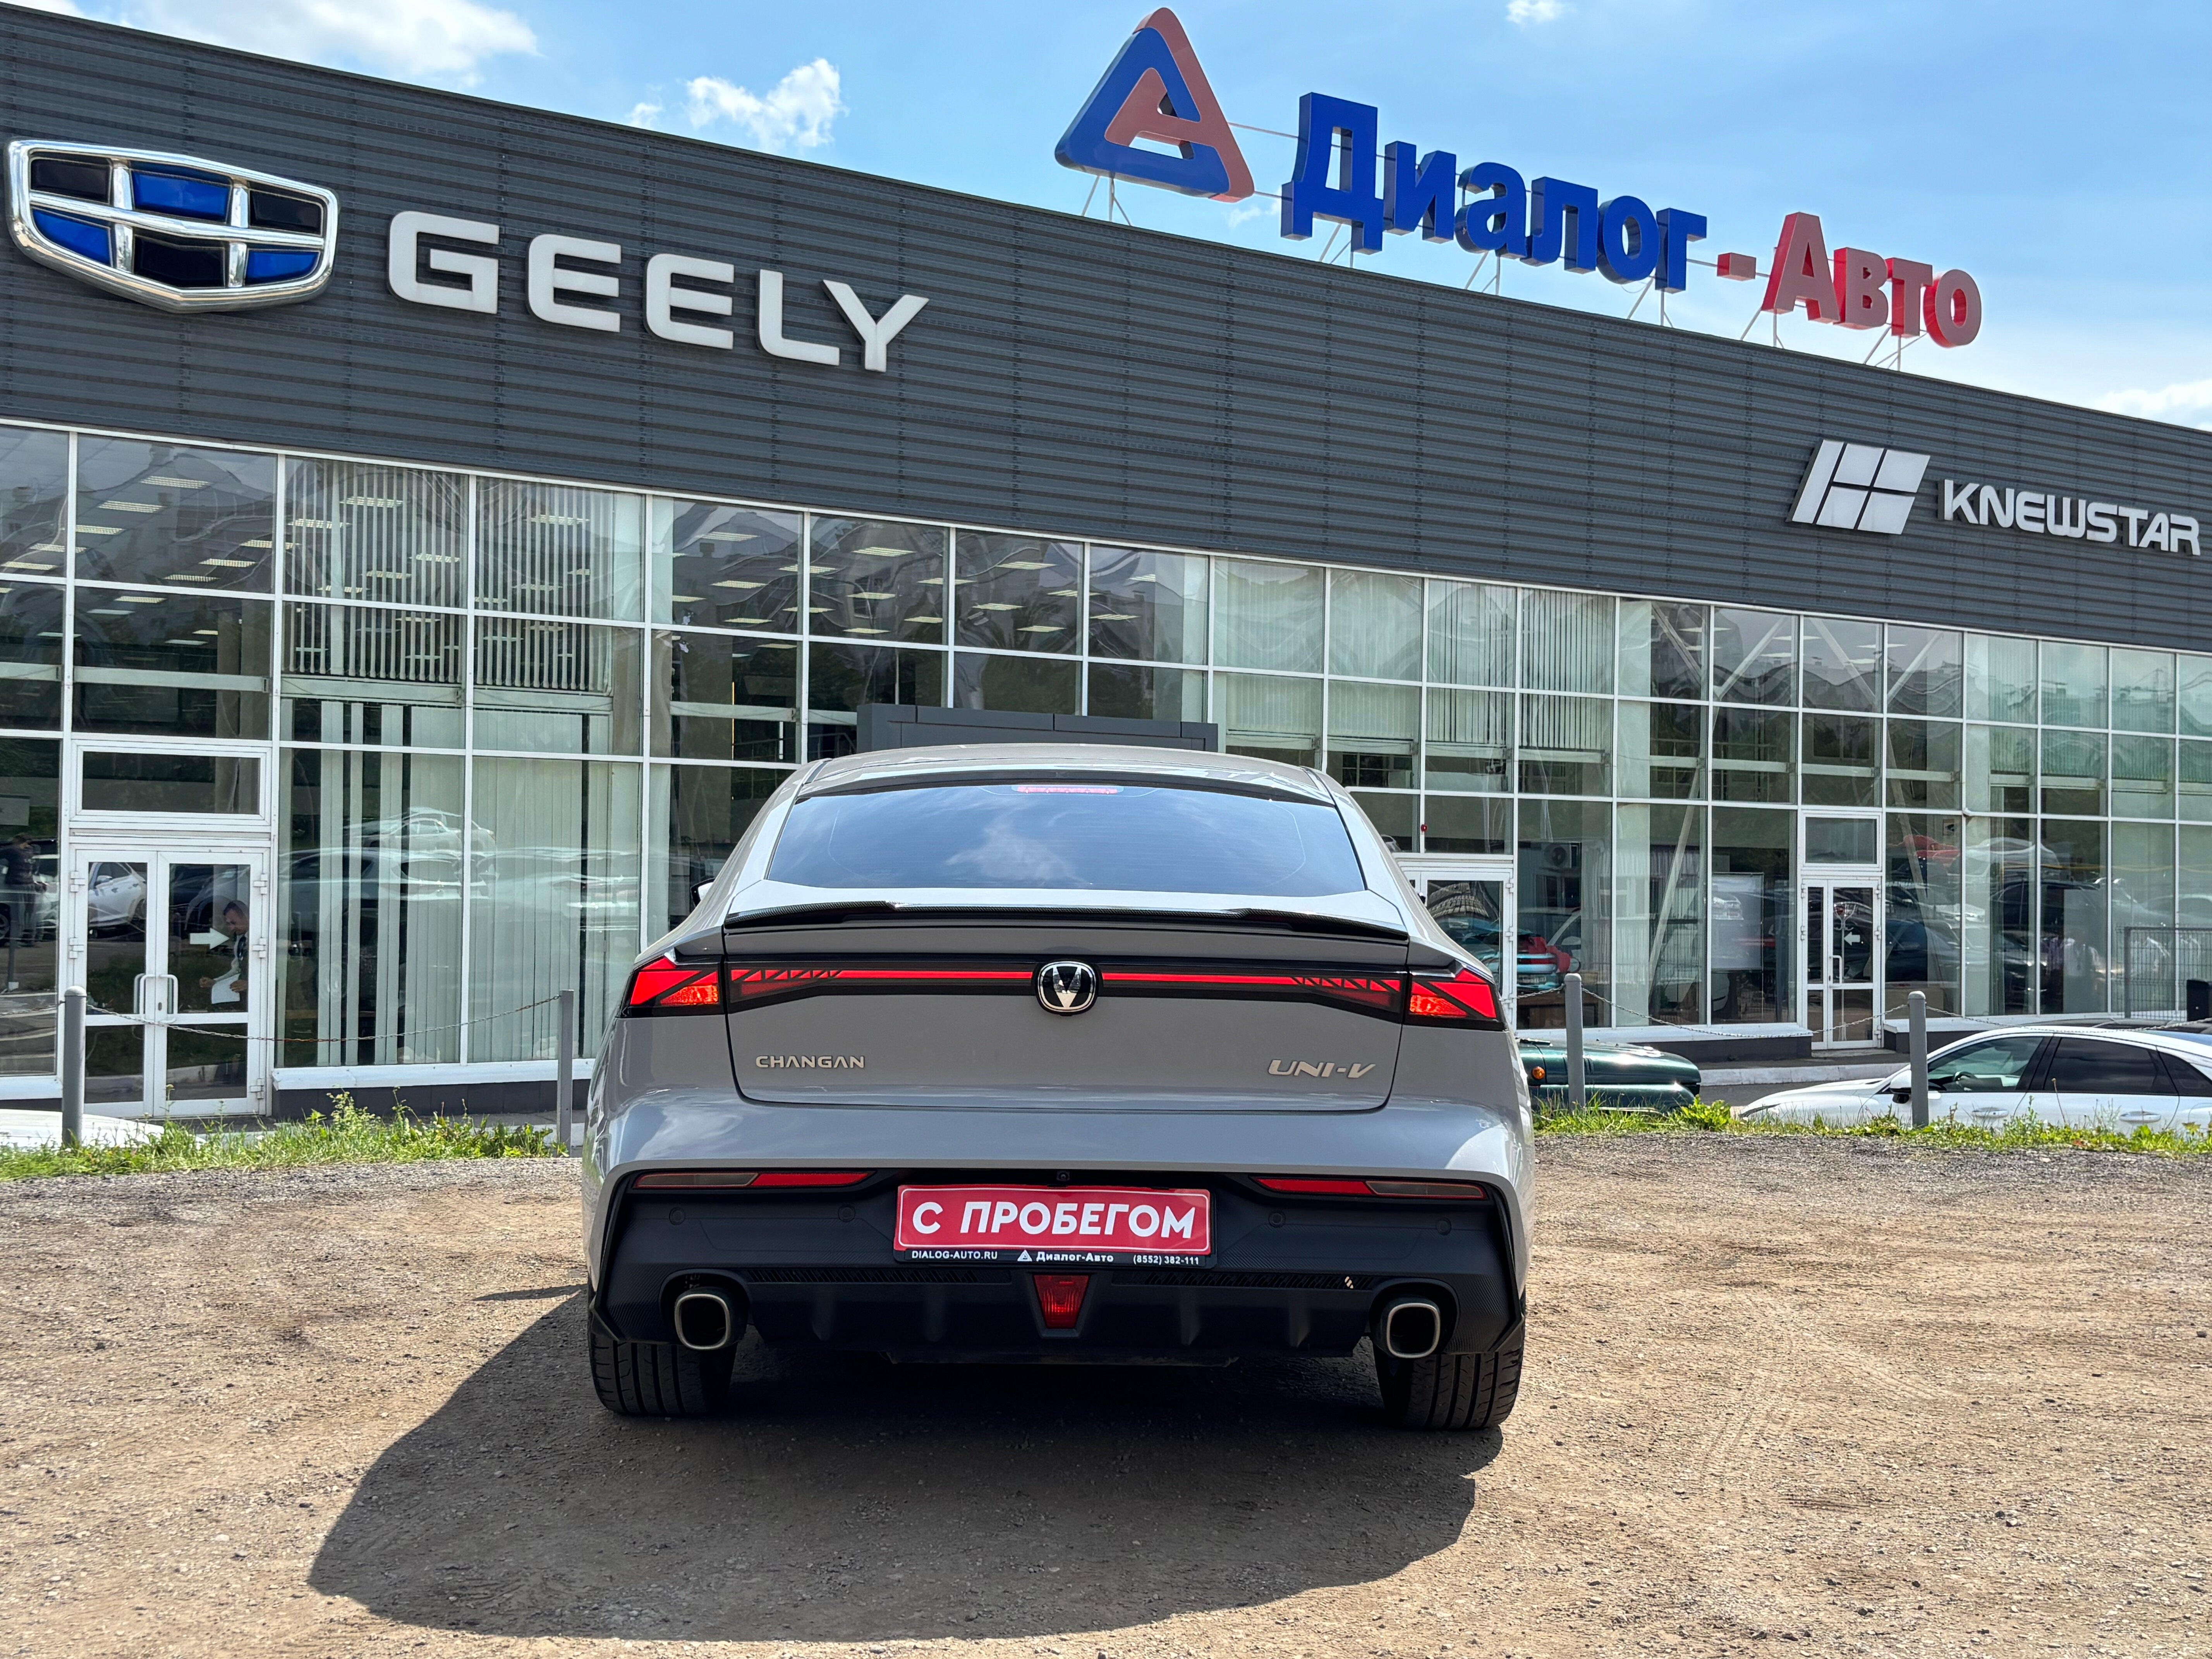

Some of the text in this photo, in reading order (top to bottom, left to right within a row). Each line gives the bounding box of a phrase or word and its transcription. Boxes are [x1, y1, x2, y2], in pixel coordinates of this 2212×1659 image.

[389, 211, 929, 372] GEELY
[1943, 479, 2201, 556] KNEWSTAR
[756, 1055, 865, 1068] CHANGAN
[1268, 1059, 1376, 1079] UNI-V
[912, 1201, 1196, 1239] С ПРОБЕГОМ
[912, 1250, 998, 1260] DIALOG-AUTO.RU
[1036, 1252, 1114, 1264] Диалог-Авто
[1133, 1254, 1199, 1266] (8552) 382-111
